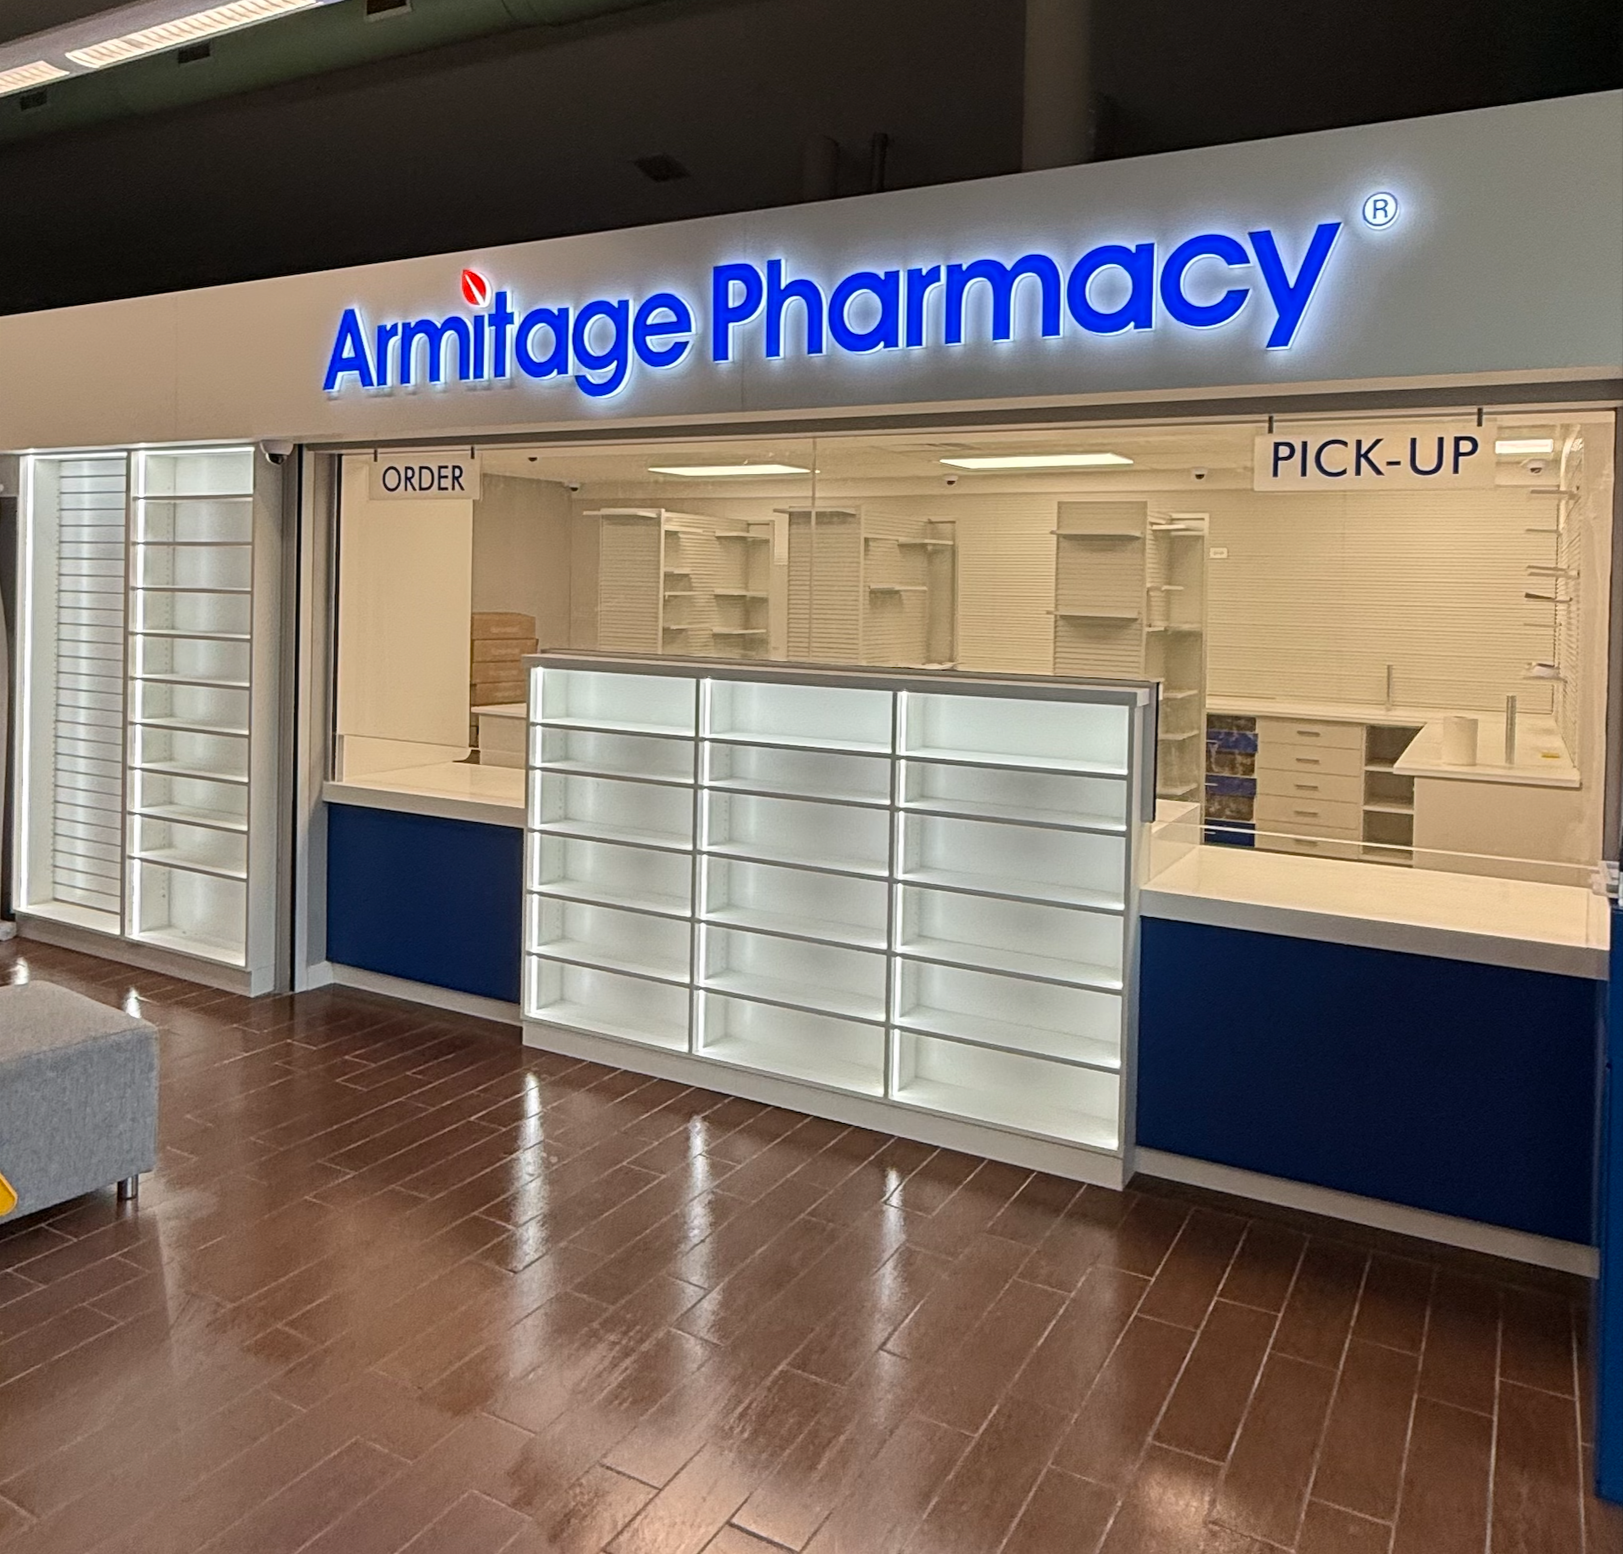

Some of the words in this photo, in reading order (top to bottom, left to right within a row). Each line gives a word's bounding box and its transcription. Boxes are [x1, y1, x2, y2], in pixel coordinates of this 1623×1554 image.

[323, 269, 692, 399] Armitage
[712, 222, 1342, 362] Pharmacy
[1271, 435, 1480, 478] PICK-UP
[381, 464, 466, 493] ORDER
